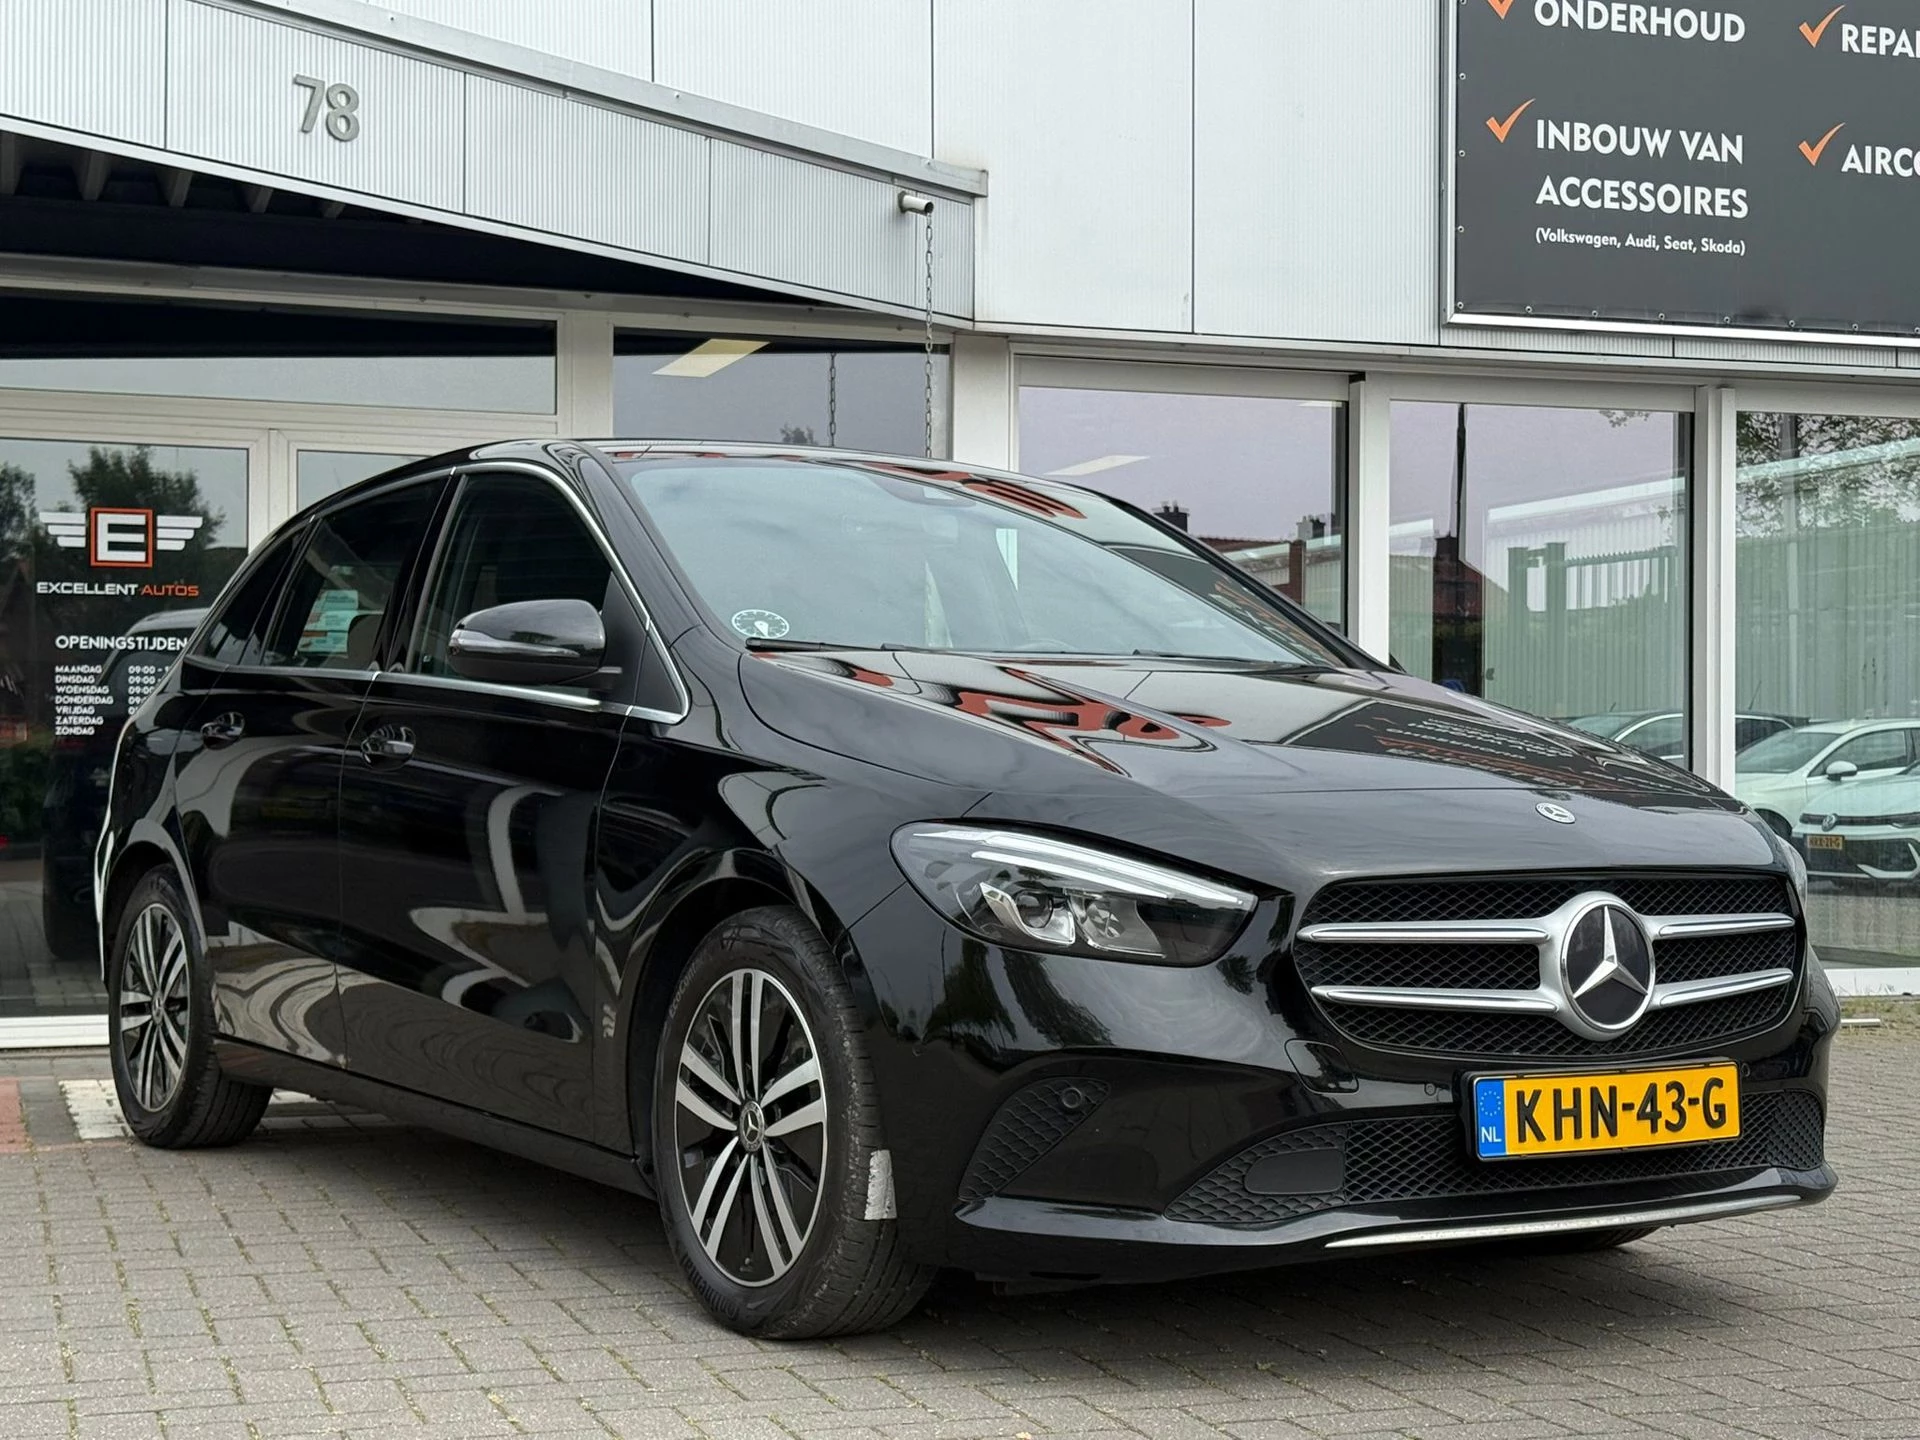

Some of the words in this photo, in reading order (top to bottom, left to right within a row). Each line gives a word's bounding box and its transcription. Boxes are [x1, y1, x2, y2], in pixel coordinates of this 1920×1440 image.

[1534, 0, 1746, 42] ONDERHOUD
[292, 74, 360, 142] 78
[1536, 119, 1672, 158] INBOUW
[1679, 130, 1743, 165] VAN
[1535, 175, 1749, 219] ACCESSOIRES
[1535, 227, 1622, 249] (Volkswagen,
[1625, 233, 1660, 251] Audi,
[1664, 236, 1698, 254] Seat,
[1701, 238, 1746, 257] Skoda)
[36, 581, 138, 596] EXCELLENT
[55, 635, 188, 650] OPENINGSTIJDEN
[55, 665, 102, 674] MAANDAG
[55, 675, 95, 684] DINSDAG
[55, 685, 109, 694] WOENSDAG
[55, 696, 114, 705] DONDERDAG
[55, 706, 95, 715] VRIJDAG
[55, 716, 104, 725] ZATERDAG
[55, 726, 95, 735] ZONDAG
[1480, 1126, 1502, 1144] NL
[1516, 1076, 1727, 1143] KHN-43-G
